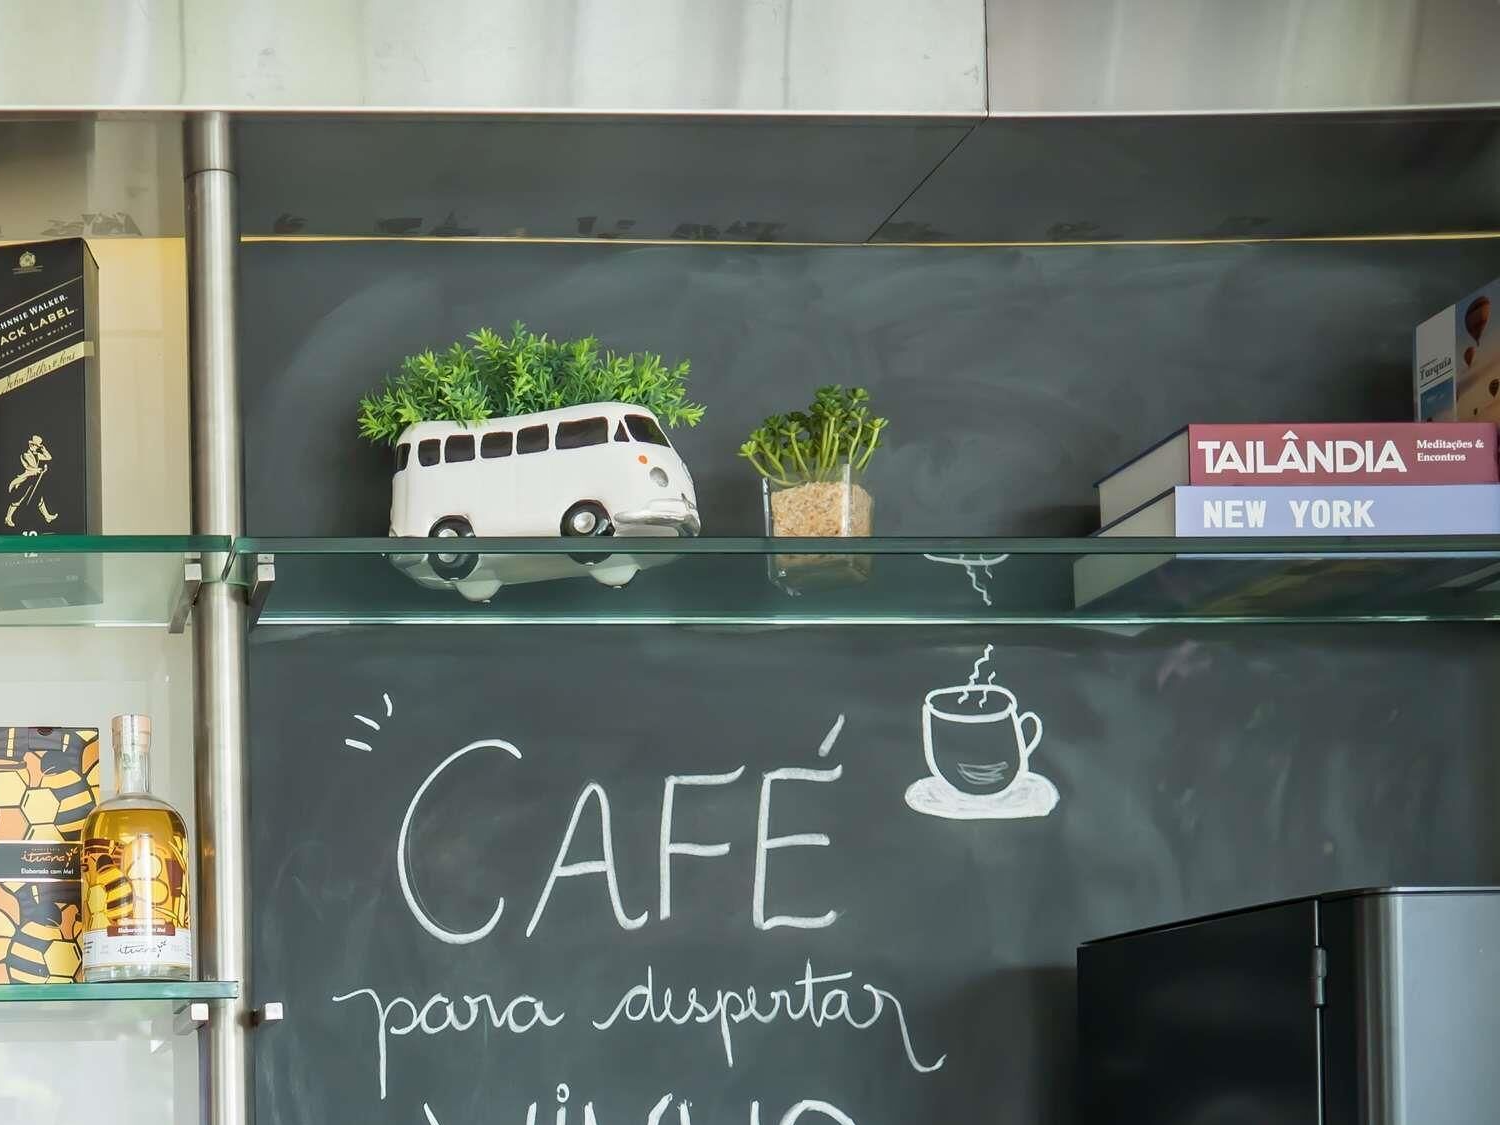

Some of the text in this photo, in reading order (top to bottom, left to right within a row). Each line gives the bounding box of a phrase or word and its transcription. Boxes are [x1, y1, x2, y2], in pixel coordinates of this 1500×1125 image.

[30, 306, 75, 331] LABEL
[1197, 430, 1407, 474] TAILÂNDIA
[1416, 439, 1485, 451] Meditações &
[1417, 453, 1467, 462] Encontros
[1203, 500, 1375, 529] NEW YORK
[397, 714, 846, 945] CAFÉ
[333, 959, 948, 1100] para despertar
